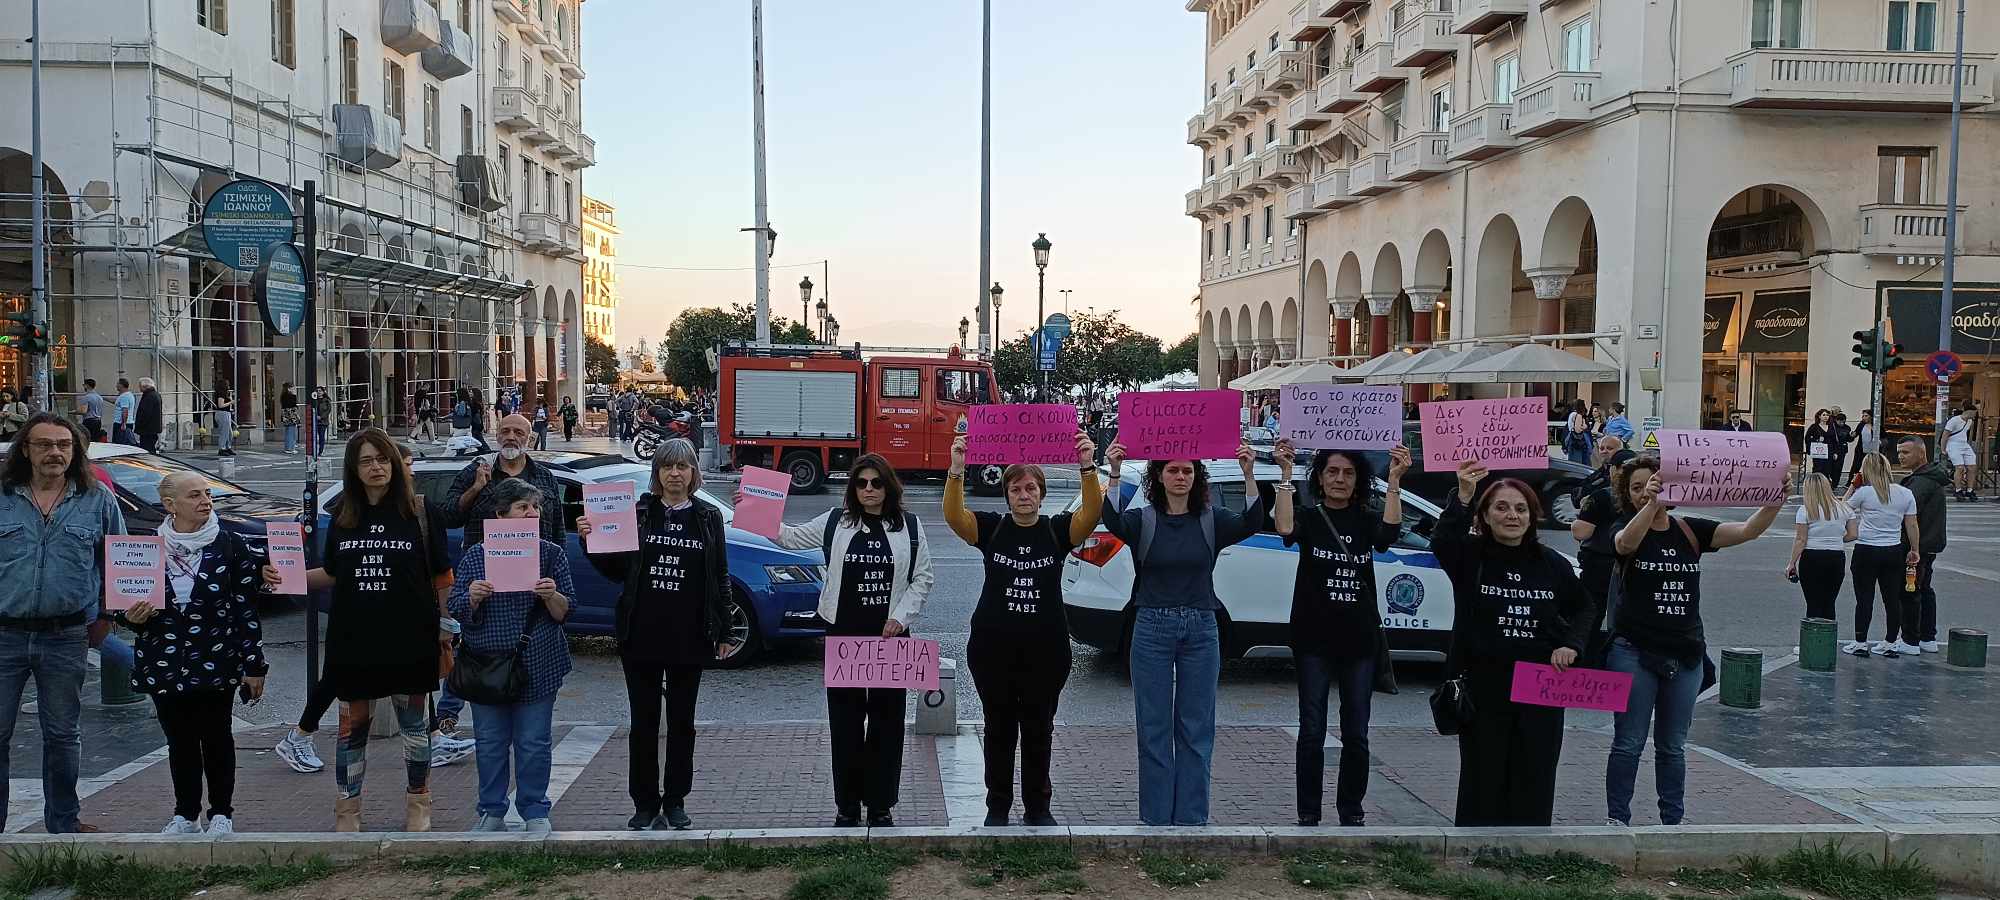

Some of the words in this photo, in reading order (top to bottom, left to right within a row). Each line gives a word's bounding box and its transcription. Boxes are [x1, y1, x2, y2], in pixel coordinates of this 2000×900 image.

[224, 194, 271, 202] ΤΣΙΜΙΣΚΗ
[224, 203, 271, 211] ΙΩΑΝΝΟΥ
[1755, 313, 1808, 330] παραδοσιακό
[1289, 386, 1317, 400] Όσο
[1329, 392, 1343, 400] το
[1303, 406, 1327, 414] την
[1435, 405, 1464, 418] Δεν
[975, 408, 1007, 424] Μας
[1316, 415, 1360, 426] εκείνος
[1292, 430, 1316, 439] την
[1457, 433, 1520, 447] λείπουν
[1678, 434, 1710, 447] Πες
[1726, 439, 1750, 448] τη
[1435, 453, 1445, 461] οι
[1452, 445, 1547, 461] ΔΟΛΟΦΟΝΗΜΕΝΕΣ
[1677, 458, 1690, 472] με
[1756, 460, 1778, 468] της
[1690, 471, 1742, 485] ΕΙΝΑΙ
[1669, 485, 1784, 501] ΓΥΝΑΙΚΟΚΤΟΝΙΑ
[370, 525, 384, 533] ΤΟ
[340, 540, 412, 550] ΠΕΡΙΠΟΛΙΚΟ
[868, 541, 881, 549] ΤΟ
[362, 555, 383, 564] ΔΕΝ
[659, 555, 680, 565] ΔΕΝ
[845, 553, 895, 564] ΕΡΙΠΟΛΙ
[993, 553, 1054, 570] ΠΕΡΙΠΟΛΙΚΟ
[355, 568, 392, 577] ΕΙΝΑΙ
[650, 566, 685, 578] ΕΙΝΑΙ
[864, 571, 884, 580] ΔΕΝ
[1336, 568, 1355, 578] ΔΕΝ
[1507, 573, 1521, 581] ΤΟ
[359, 582, 388, 590] ΤΑΞΙ
[652, 580, 680, 590] ΤΑΞΙ
[858, 582, 891, 591] ΕΙΝΑΙ
[1014, 577, 1033, 586] ΔΕΝ
[1663, 581, 1684, 590] ΔΕΝ
[1005, 588, 1040, 599] ΕΙΝΑΙ
[1330, 592, 1357, 601] ΤΑΞΙ
[1481, 585, 1554, 600] ΠΕΡΙΠΟΛΙΚΟ
[1654, 593, 1691, 601] ΕΙΝΑΙ
[862, 595, 888, 605] ΤΑΞΙ
[1008, 603, 1036, 612] ΤΑΞΙ
[1507, 605, 1530, 615] ΔΕΝ
[1658, 606, 1685, 615] ΤΑΞΙ
[1384, 618, 1429, 627] OLICE
[1498, 617, 1539, 627] ΕΙΝΑΙ
[838, 640, 888, 661] ΟΥΤΕ
[896, 640, 930, 664] ΜΙΑ
[833, 663, 925, 681] ΛΙΓΟΤΕΡΗ
